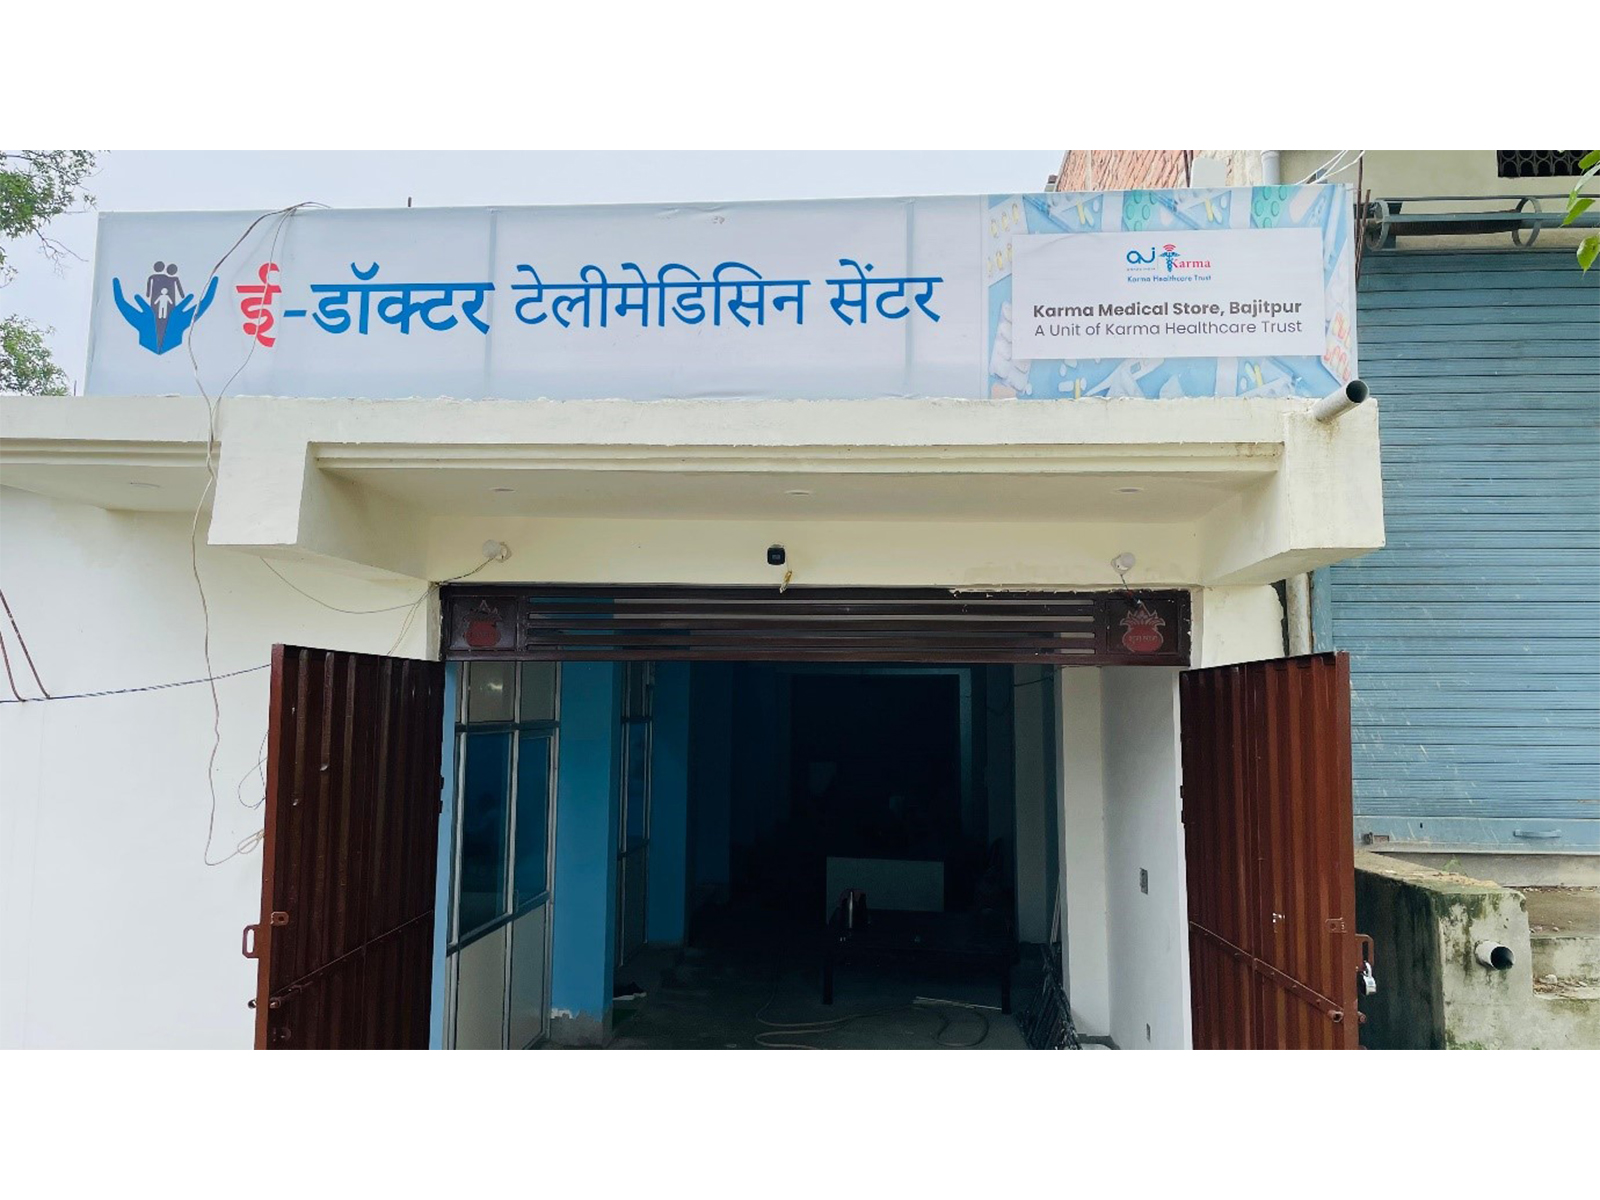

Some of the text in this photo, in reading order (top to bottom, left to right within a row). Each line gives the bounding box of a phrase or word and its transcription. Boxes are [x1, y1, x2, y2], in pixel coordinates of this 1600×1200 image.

[1153, 274, 1192, 282] Healthcare
[235, 258, 944, 348] ई-डॉक्टर टेलीमेडिसिन सेंटर
[1033, 299, 1302, 318] Karma Medical Store, Bajitpur
[1034, 320, 1302, 336] A Unit of Karma Healthcare Trust
